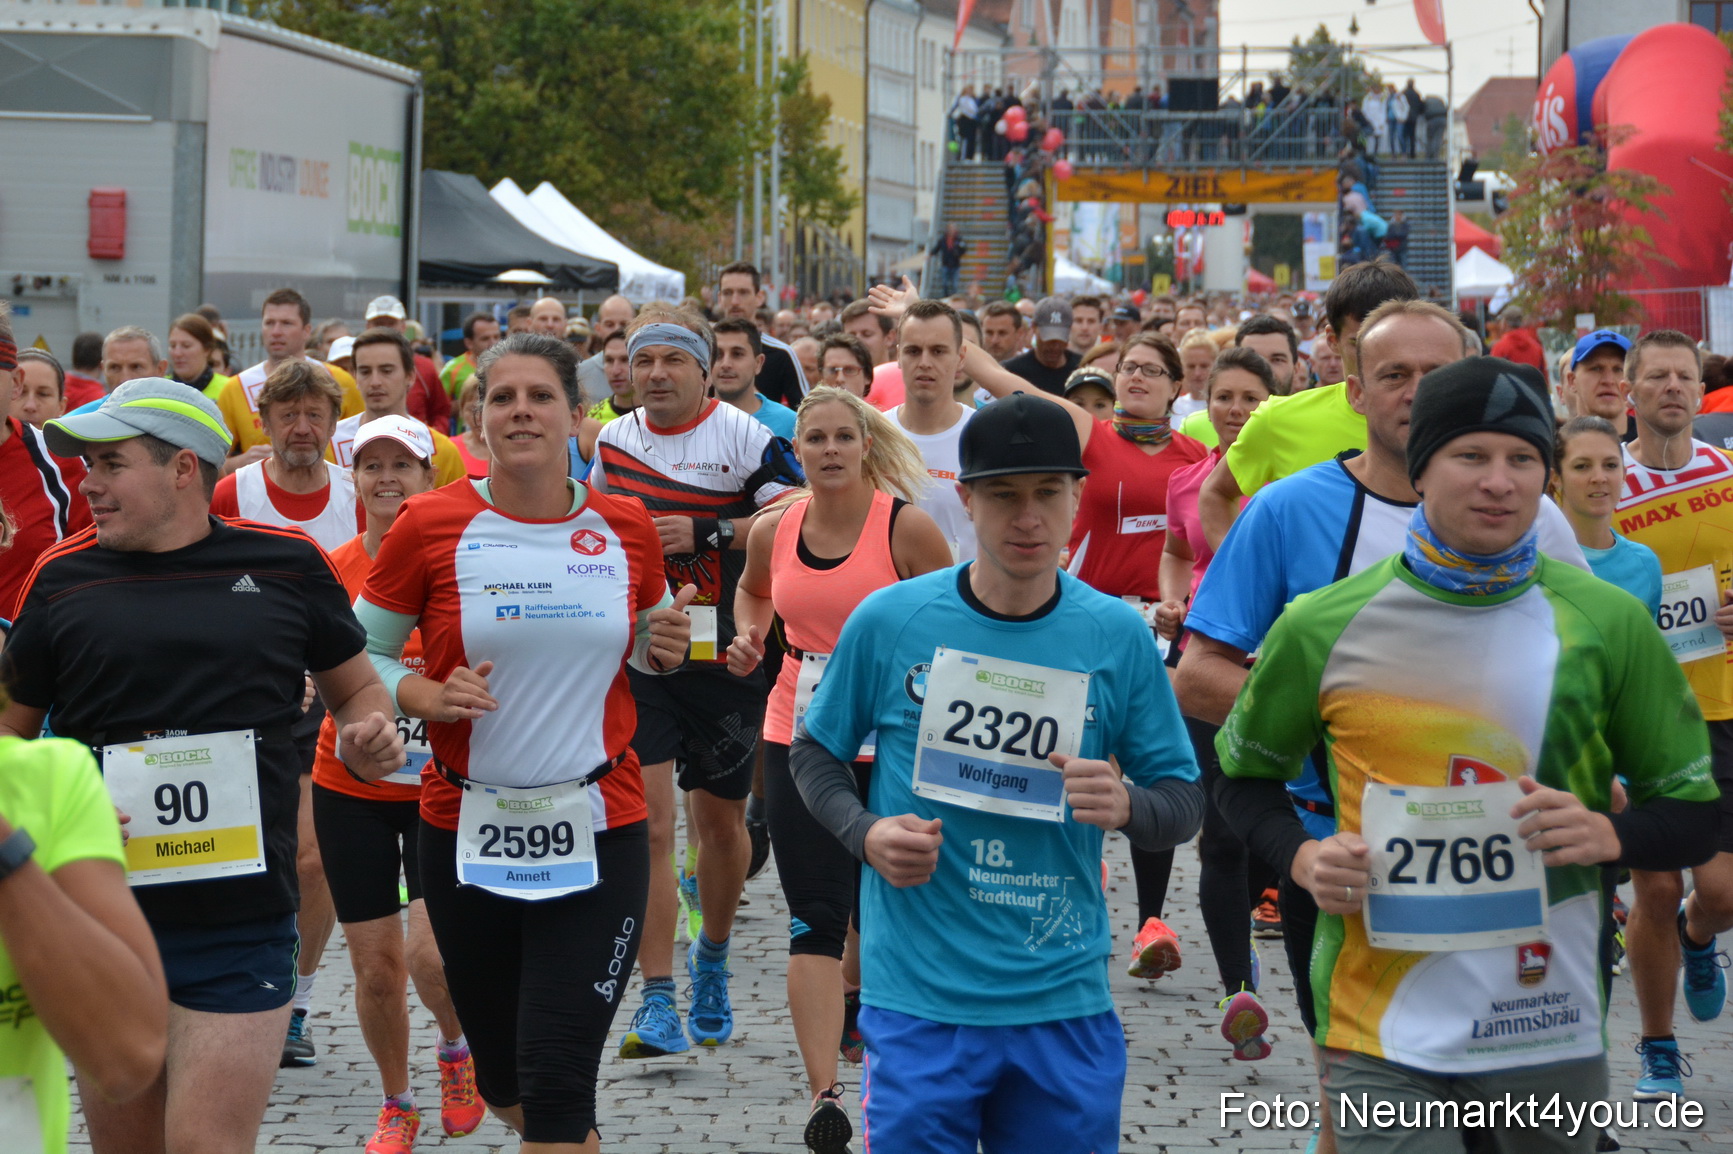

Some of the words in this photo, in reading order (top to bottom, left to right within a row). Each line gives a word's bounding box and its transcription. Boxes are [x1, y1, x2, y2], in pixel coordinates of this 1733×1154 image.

[1165, 176, 1226, 198] ZIEL
[672, 462, 720, 471] NEUMARKT
[1136, 519, 1159, 528] DEHN
[1619, 502, 1683, 535] MAX
[567, 563, 616, 577] KOPPE
[231, 585, 261, 593] adidas
[484, 582, 525, 590] MICHAEL
[525, 603, 583, 611] Raiffeisenbank
[525, 611, 564, 619] Neumarkt
[992, 672, 1046, 694] BOCK
[943, 700, 1059, 760] 2320
[160, 748, 211, 764] BOCK
[958, 762, 1028, 792] Wolfgang
[154, 780, 208, 825] 90
[509, 796, 553, 810] BOCK
[1421, 800, 1485, 816] BOCK
[155, 837, 215, 857] Michael
[478, 820, 575, 859] 2599
[970, 839, 1013, 868] 18.
[1385, 834, 1514, 884] 2766
[506, 870, 551, 882] Annett
[969, 867, 1059, 888] Neumarkter
[969, 887, 1046, 911] Stadtlauf
[1036, 914, 1063, 946] September
[609, 917, 635, 976] odlo
[1491, 991, 1571, 1015] Neumarkter
[1472, 1005, 1580, 1039] Lammsbräu
